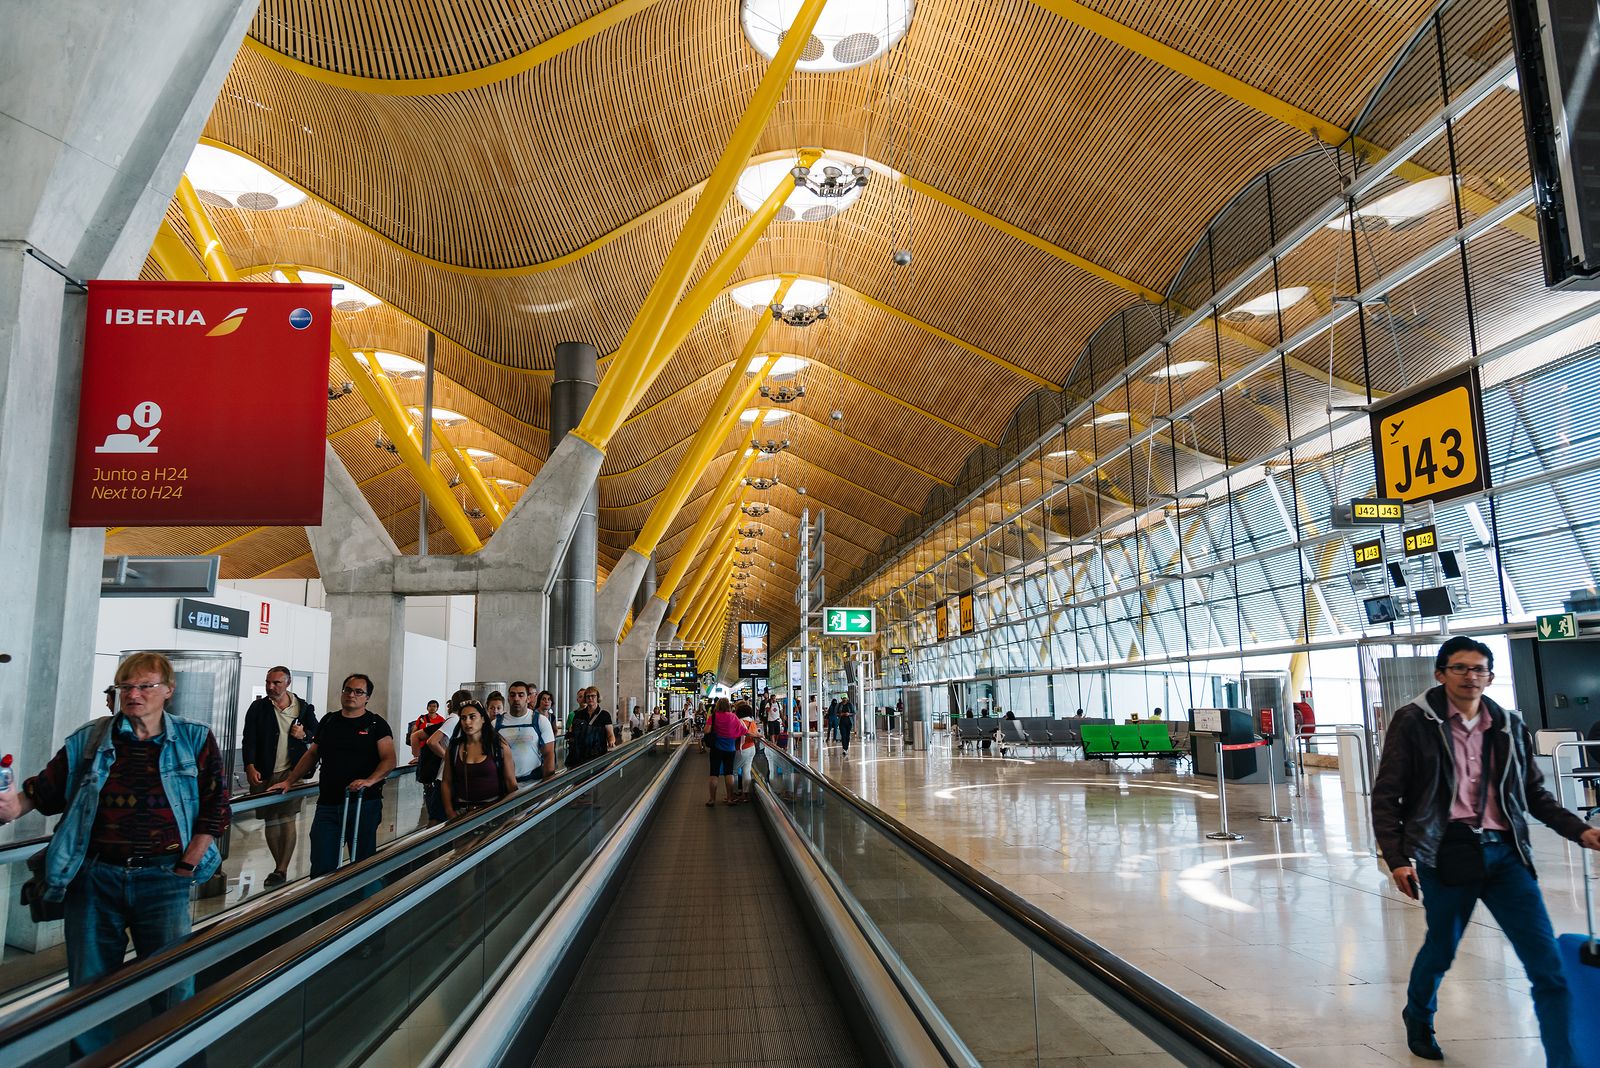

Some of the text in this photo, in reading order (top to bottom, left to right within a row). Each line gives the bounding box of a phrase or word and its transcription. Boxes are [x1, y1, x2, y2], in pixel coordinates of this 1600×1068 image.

[105, 308, 206, 326] IBERIA
[1395, 428, 1465, 493] J43
[92, 467, 188, 481] Junto a H24
[91, 486, 183, 500] Next to H24
[1358, 506, 1399, 517] J42 J43
[1419, 534, 1432, 546] J42
[1366, 547, 1378, 559] J43
